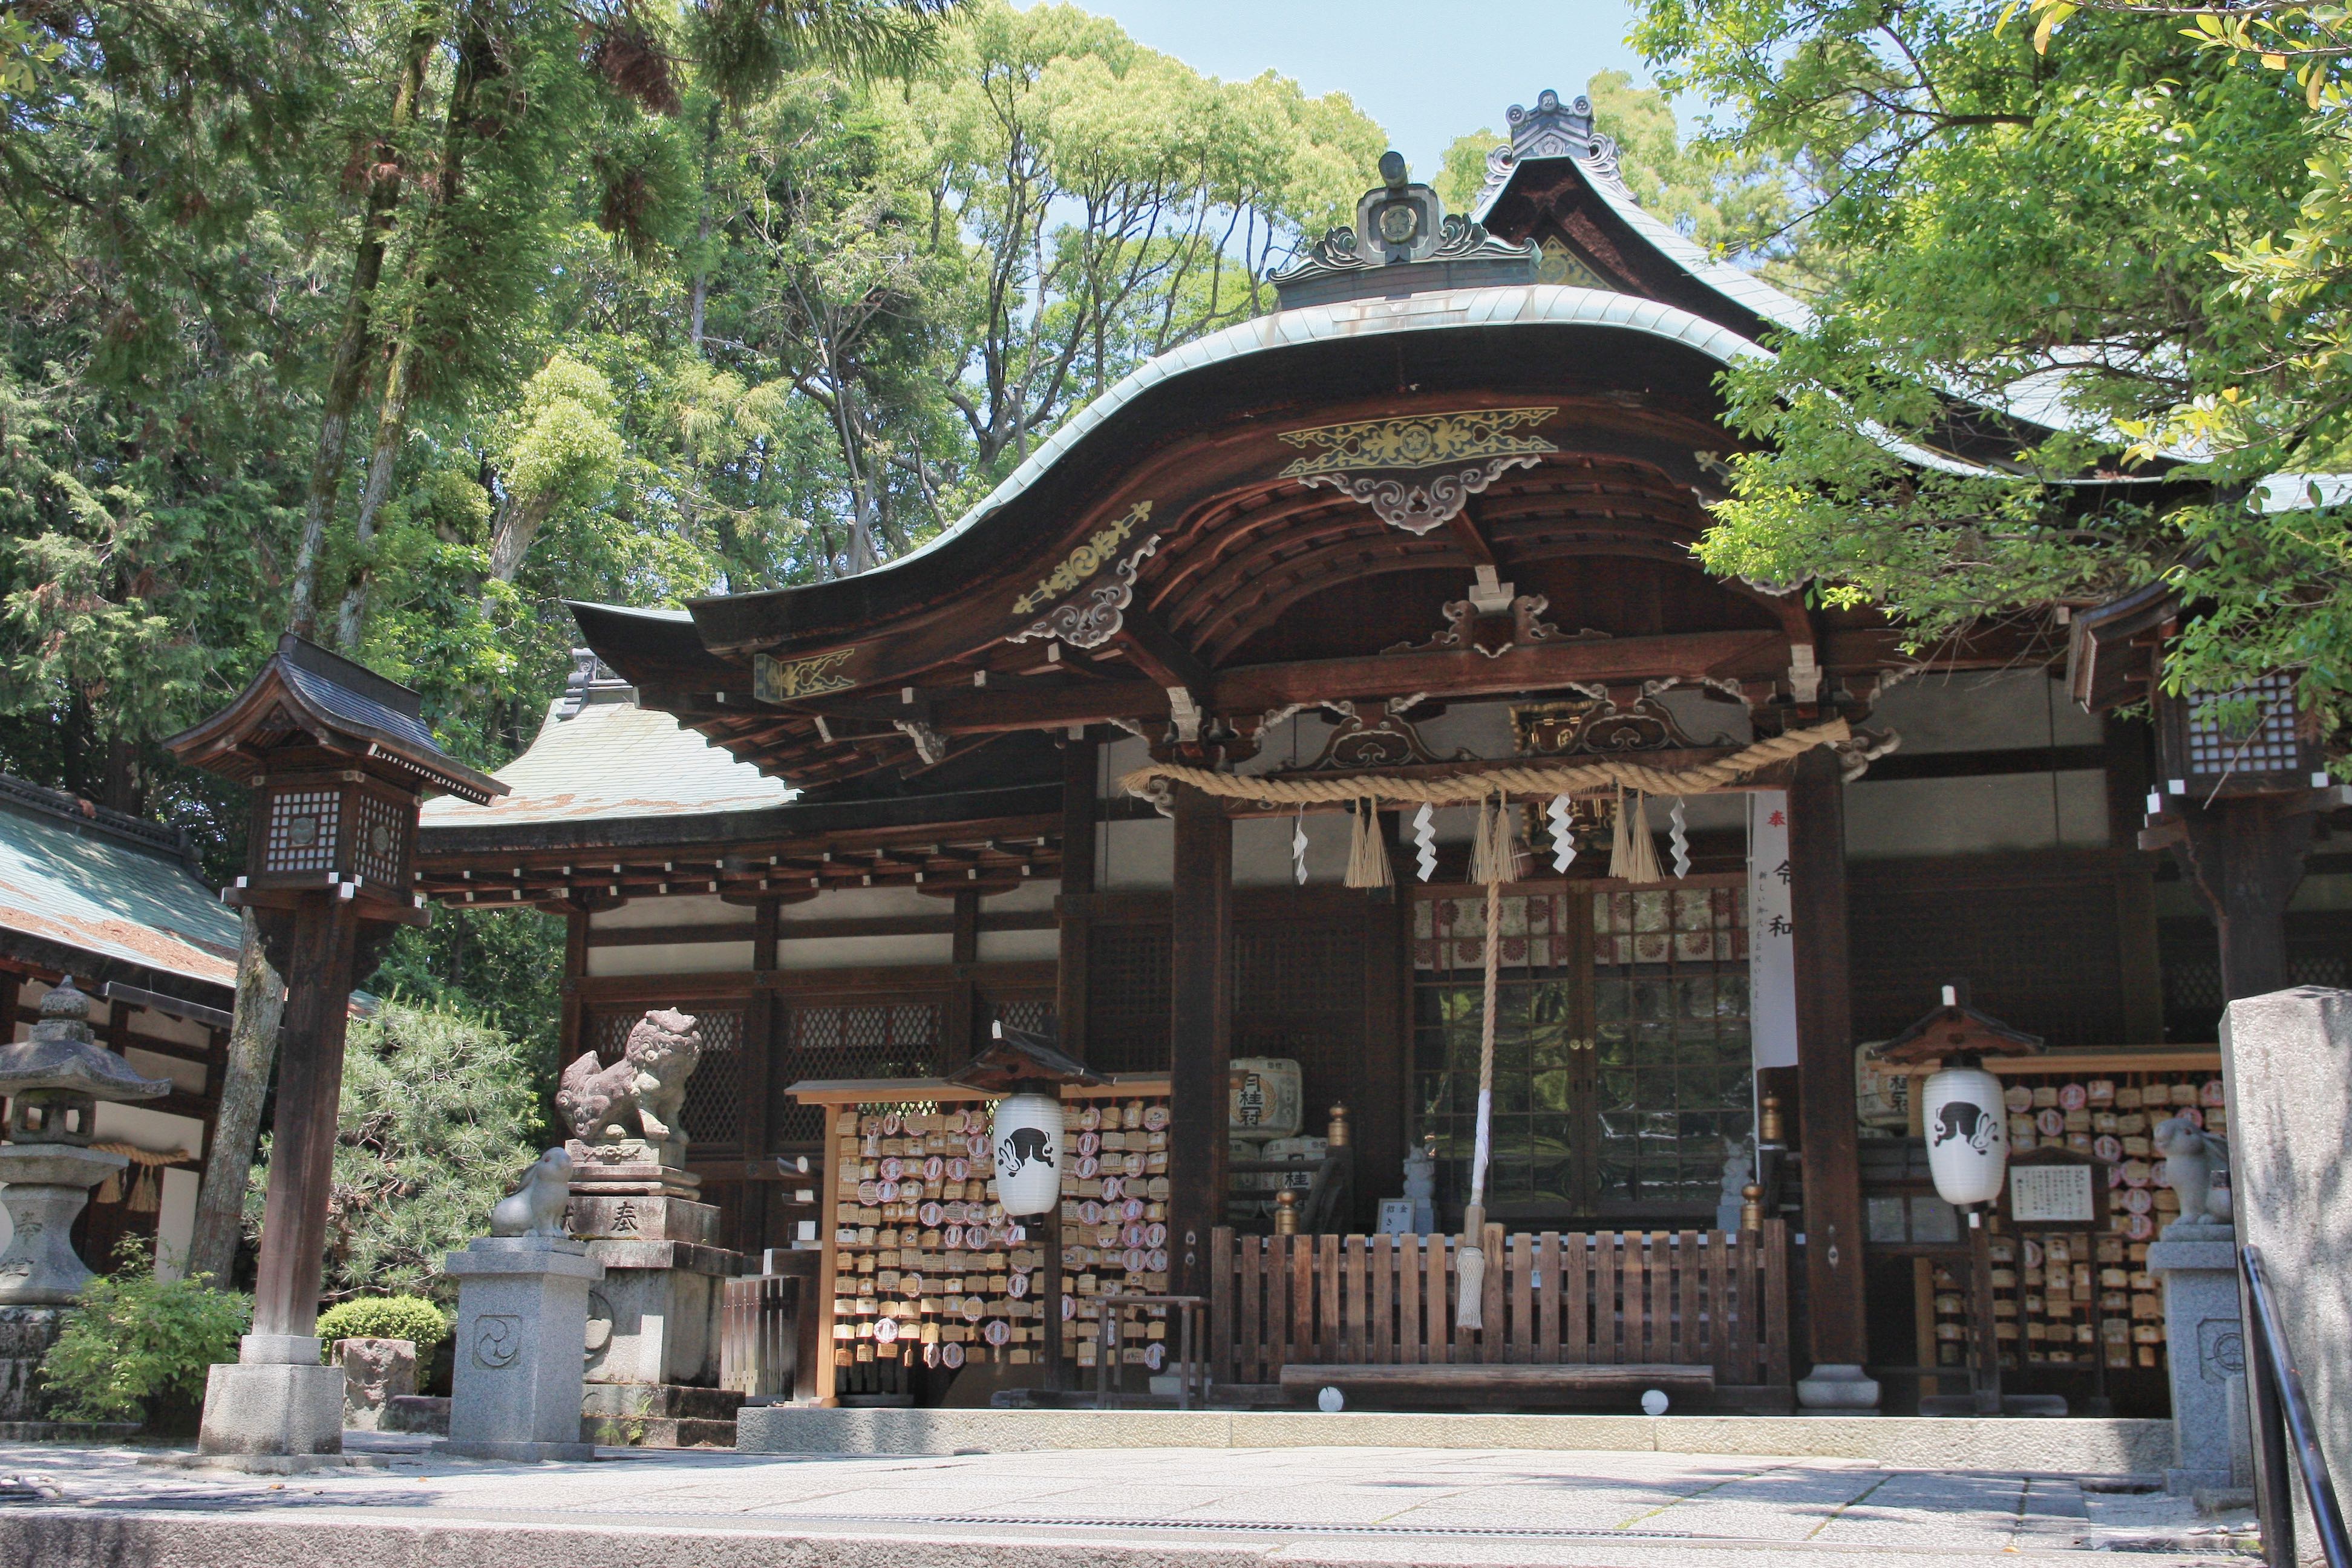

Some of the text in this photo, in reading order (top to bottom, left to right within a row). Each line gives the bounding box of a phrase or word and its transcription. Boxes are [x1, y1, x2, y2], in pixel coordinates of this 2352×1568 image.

[1768, 810, 1786, 828] 奉
[1768, 859, 1793, 938] 令和
[1239, 1073, 1263, 1125] 月桂冠
